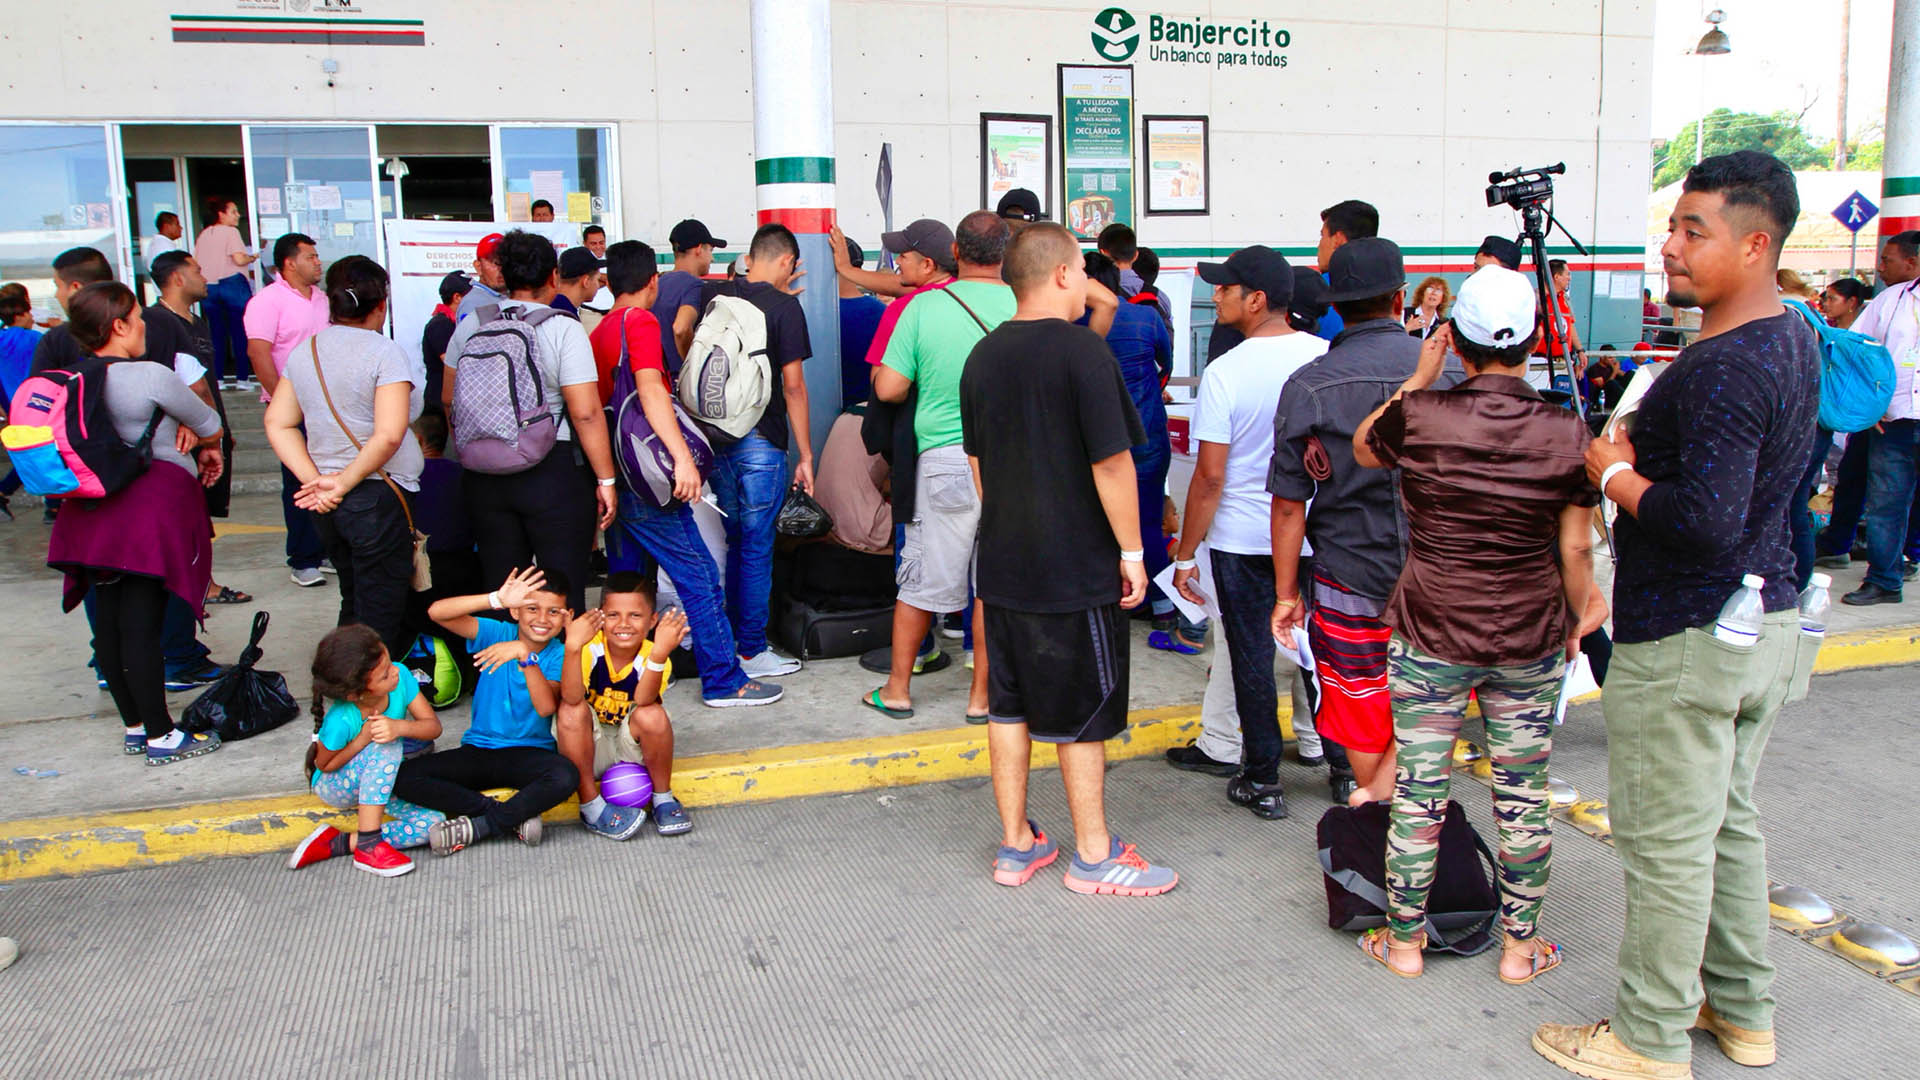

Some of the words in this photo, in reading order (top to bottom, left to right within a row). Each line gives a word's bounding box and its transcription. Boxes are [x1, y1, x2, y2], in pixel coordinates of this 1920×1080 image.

[1149, 14, 1291, 48] Banjercito
[1170, 46, 1211, 64] banco
[1217, 52, 1247, 70] para
[1250, 50, 1288, 68] todos
[1075, 126, 1121, 135] DECLÁRALOS
[426, 252, 474, 260] DERECHOS
[432, 261, 444, 269] DE
[446, 261, 474, 269] PERSO
[704, 356, 725, 418] avia
